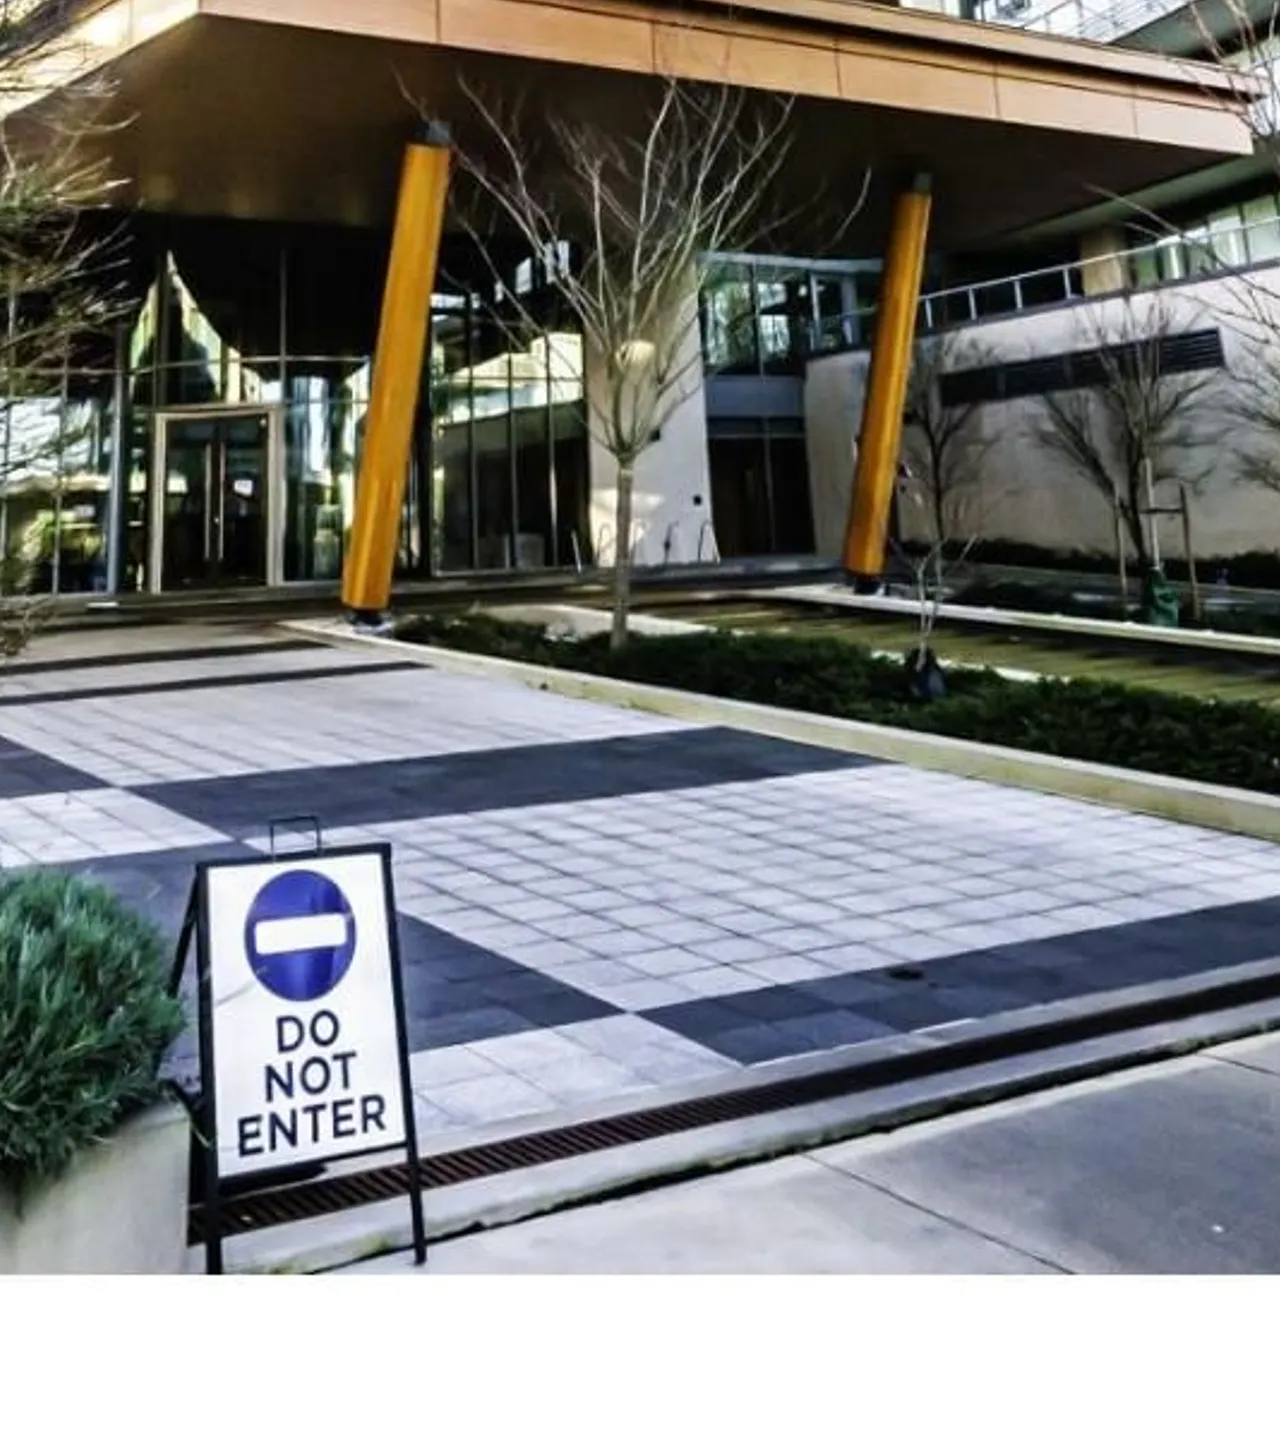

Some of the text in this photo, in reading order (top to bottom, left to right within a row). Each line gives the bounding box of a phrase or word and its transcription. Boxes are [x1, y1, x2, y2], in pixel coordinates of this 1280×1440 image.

[276, 1009, 340, 1054] DO
[264, 1050, 357, 1103] NOT
[237, 1093, 387, 1158] ENTER
